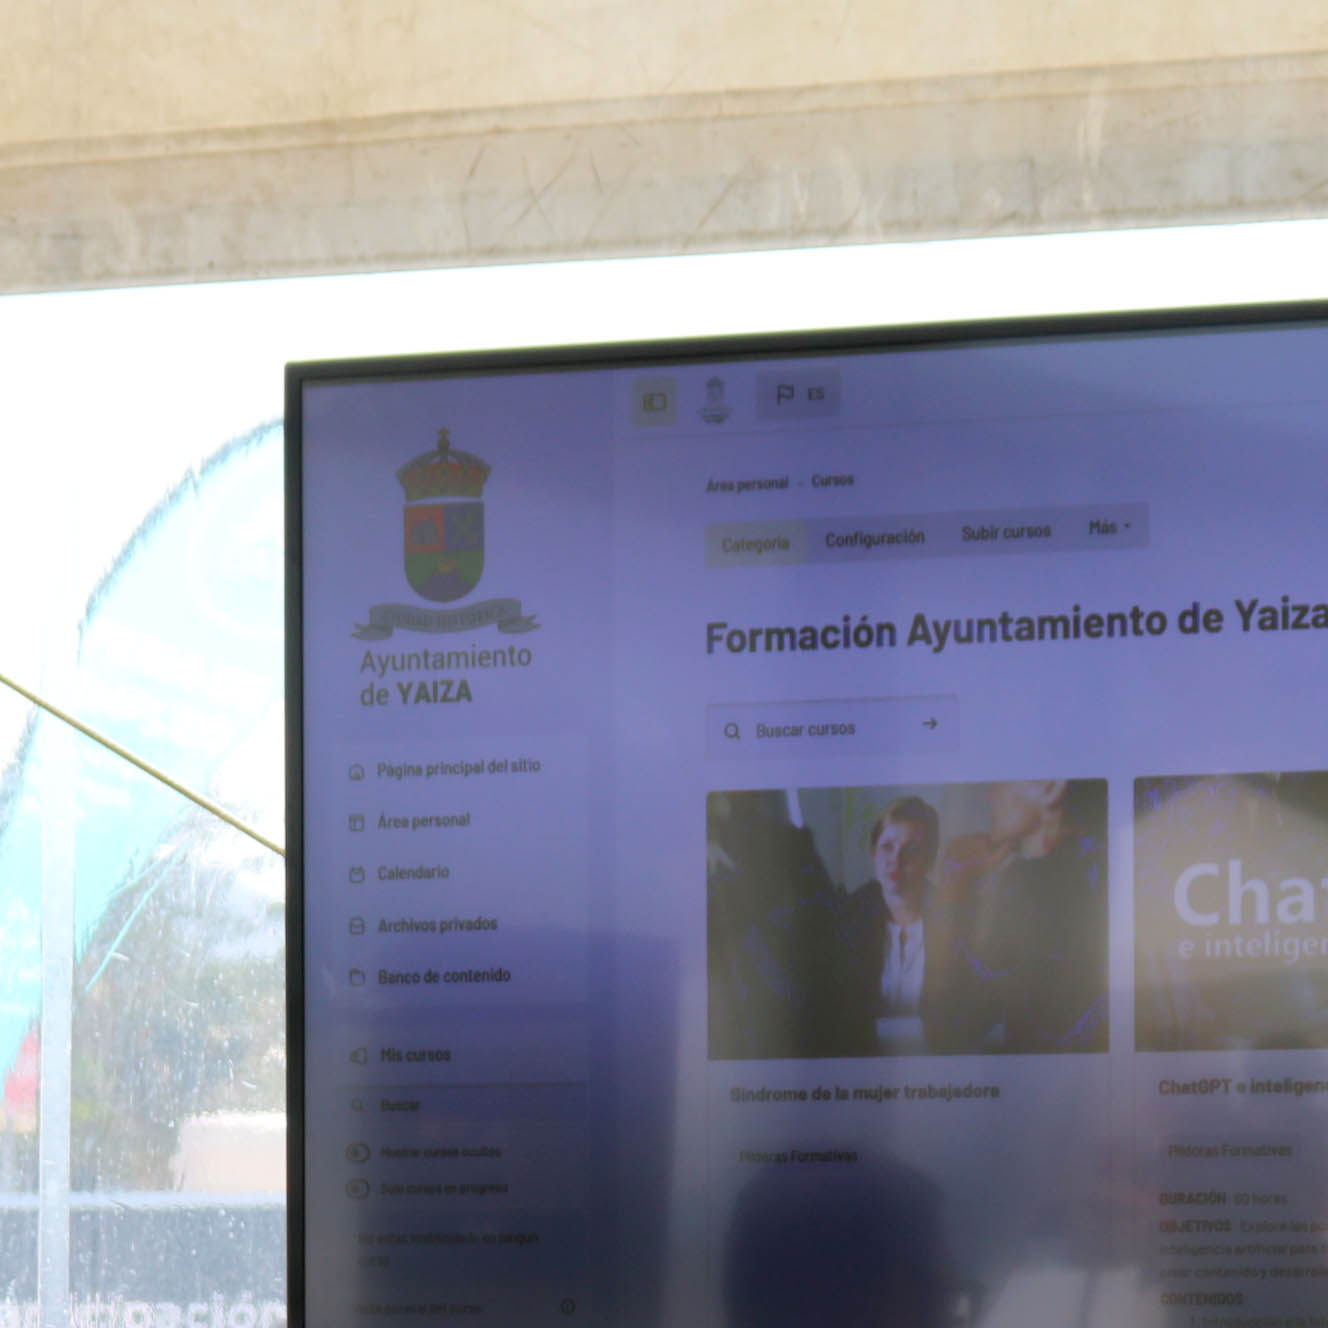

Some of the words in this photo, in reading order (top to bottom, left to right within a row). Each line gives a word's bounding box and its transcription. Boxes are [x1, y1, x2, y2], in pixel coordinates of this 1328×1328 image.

[810, 472, 855, 489] Cursos
[825, 528, 926, 550] Configuración
[960, 524, 1000, 543] Subir
[1002, 522, 1052, 540] cursos
[705, 614, 897, 655] Formación
[906, 603, 1168, 654] Ayuntamiento
[1178, 600, 1224, 636] de
[360, 644, 532, 679] Ayuntamiento
[360, 682, 388, 707] de
[396, 679, 473, 704] YAIZA
[755, 719, 805, 740] Buscar
[808, 719, 856, 738] cursos
[426, 759, 484, 779] principal
[487, 758, 508, 774] del
[510, 755, 542, 774] sitio
[411, 811, 470, 831] personal
[377, 864, 450, 880] Calendario
[378, 917, 437, 933] Archivos
[439, 915, 498, 935] privados
[1178, 938, 1194, 960] e
[378, 968, 421, 985] Banco
[424, 968, 440, 984] de
[443, 966, 512, 983] contenido
[812, 1085, 832, 1101] de
[835, 1084, 849, 1100] la
[853, 1084, 900, 1103] mujer
[904, 1081, 1001, 1102] trabajadora
[1158, 1078, 1232, 1095] ChatGPT
